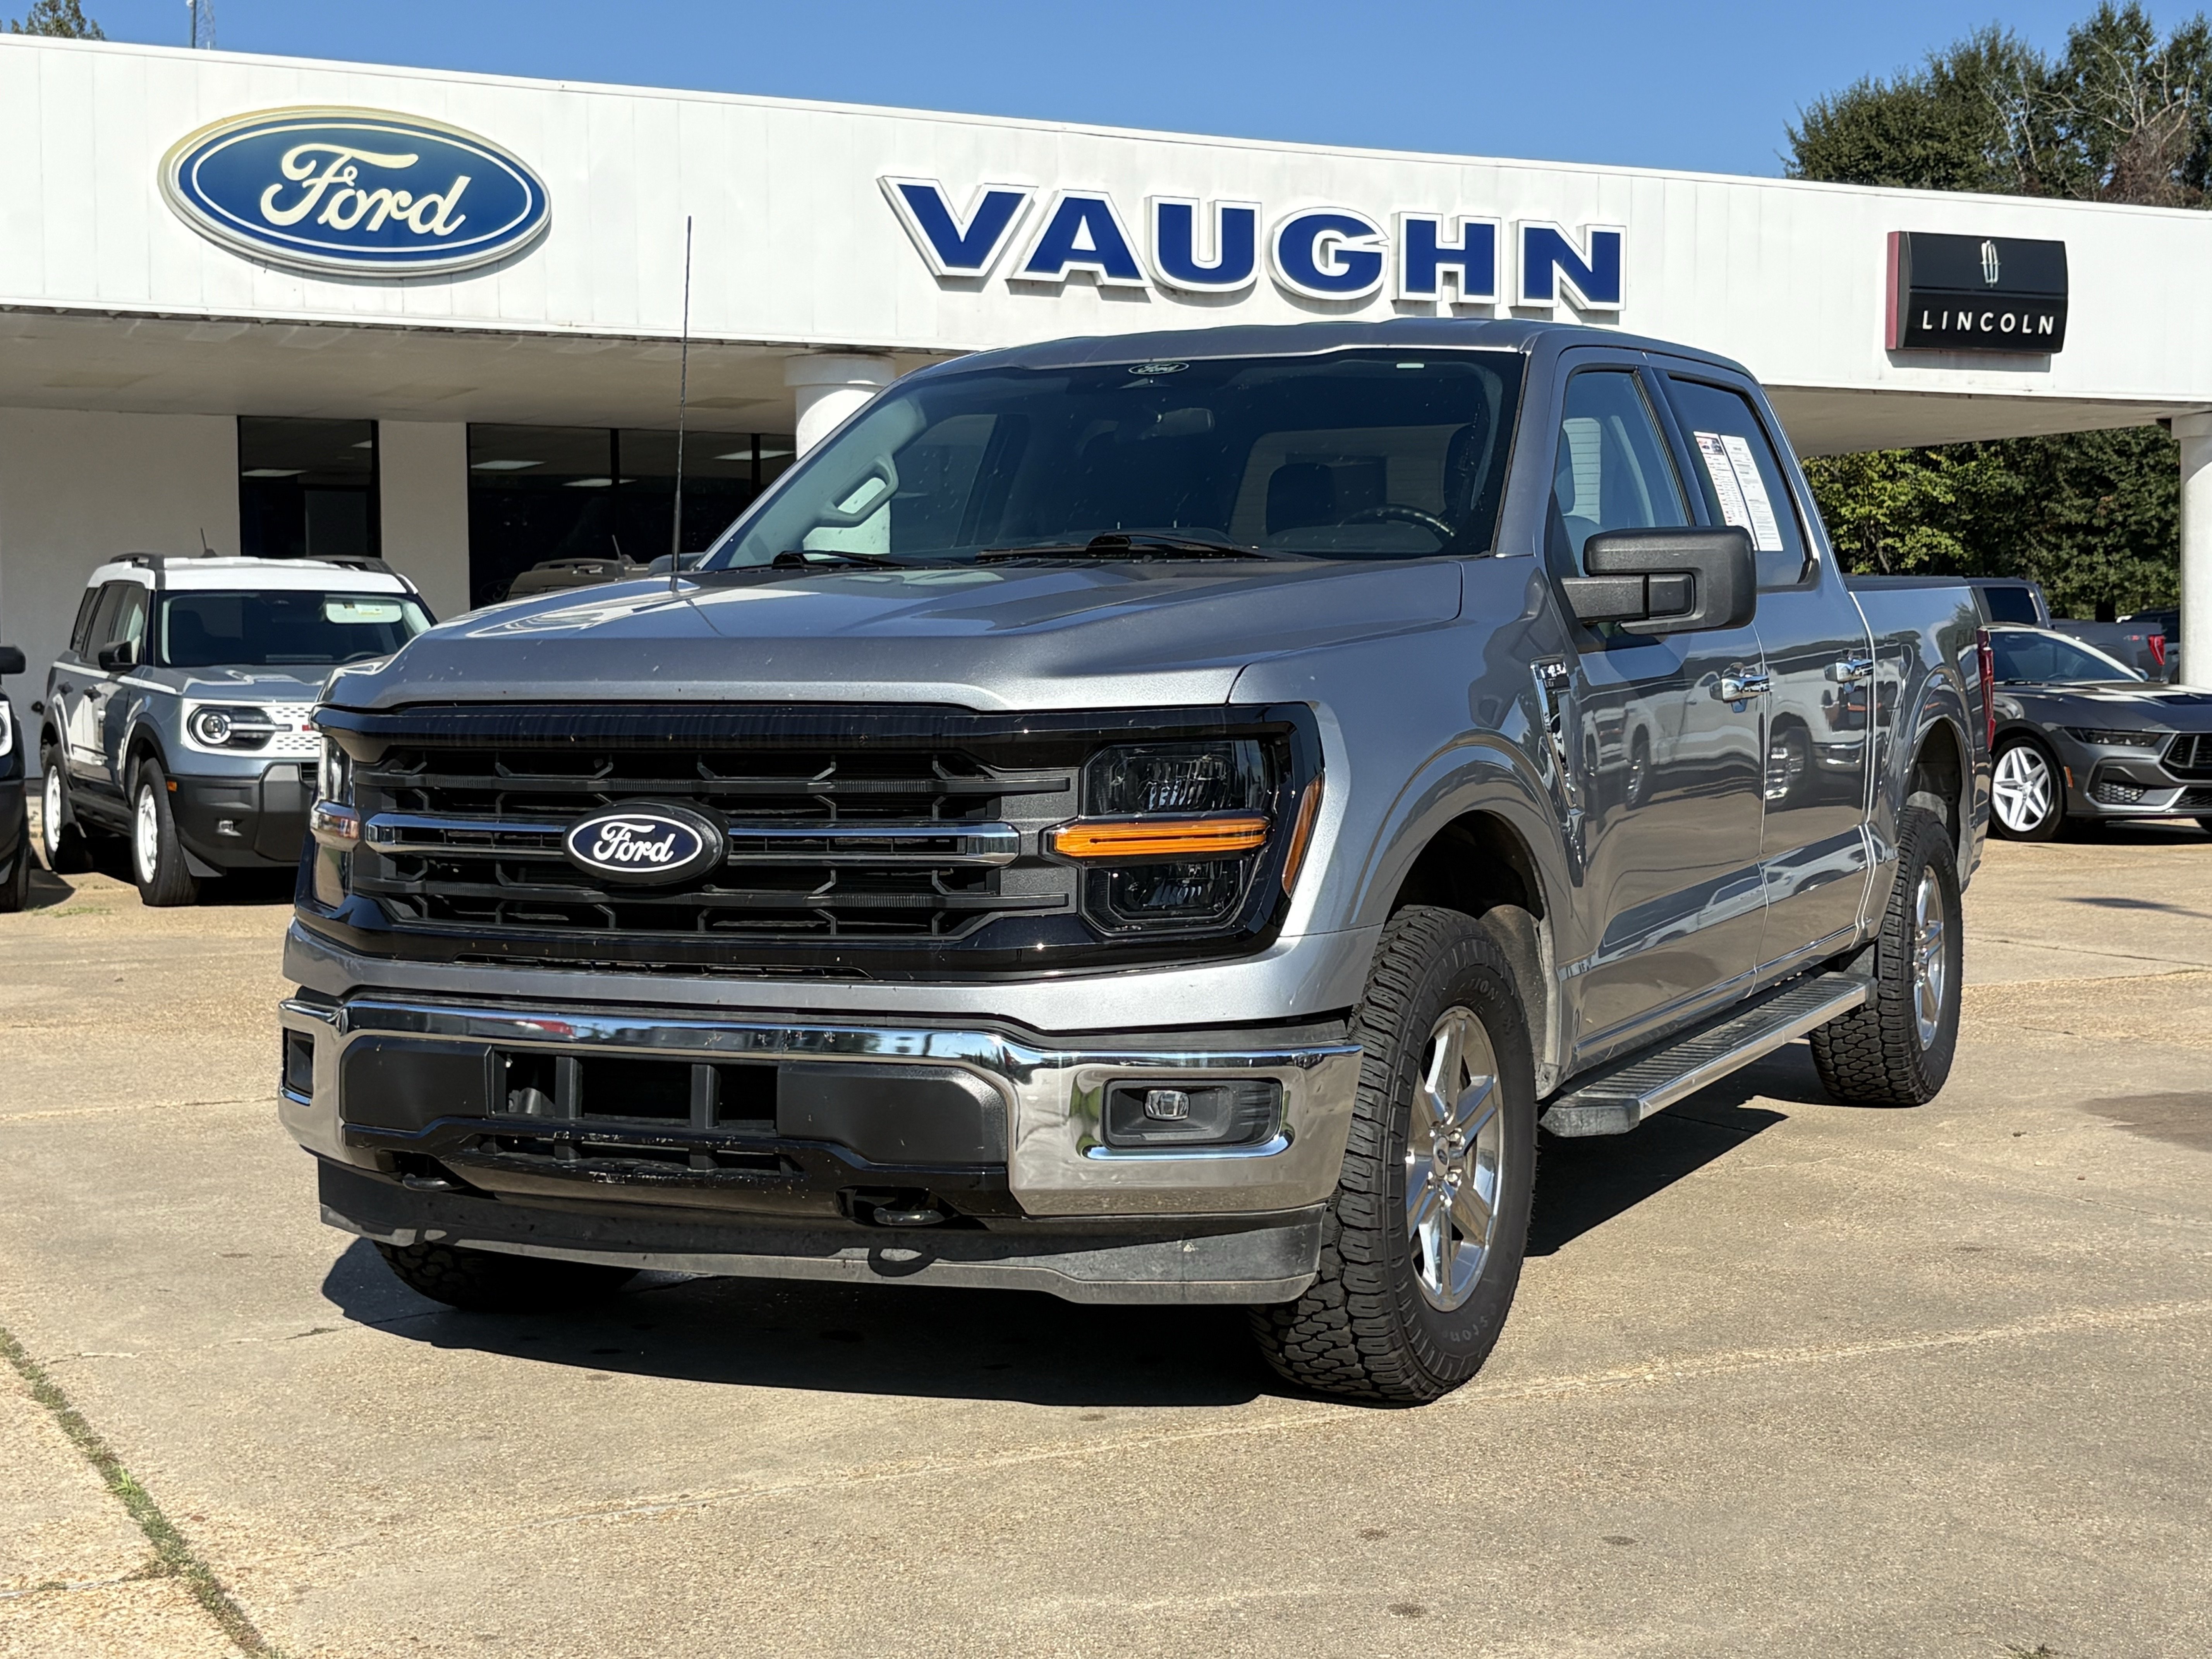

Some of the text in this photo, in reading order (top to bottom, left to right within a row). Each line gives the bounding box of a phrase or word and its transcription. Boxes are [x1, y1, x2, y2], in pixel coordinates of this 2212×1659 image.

[261, 143, 471, 236] Ford
[897, 184, 1620, 303] VAUGHN
[1922, 310, 2054, 335] LINCOLN
[1138, 363, 1180, 373] Ford
[593, 822, 676, 862] Ford
